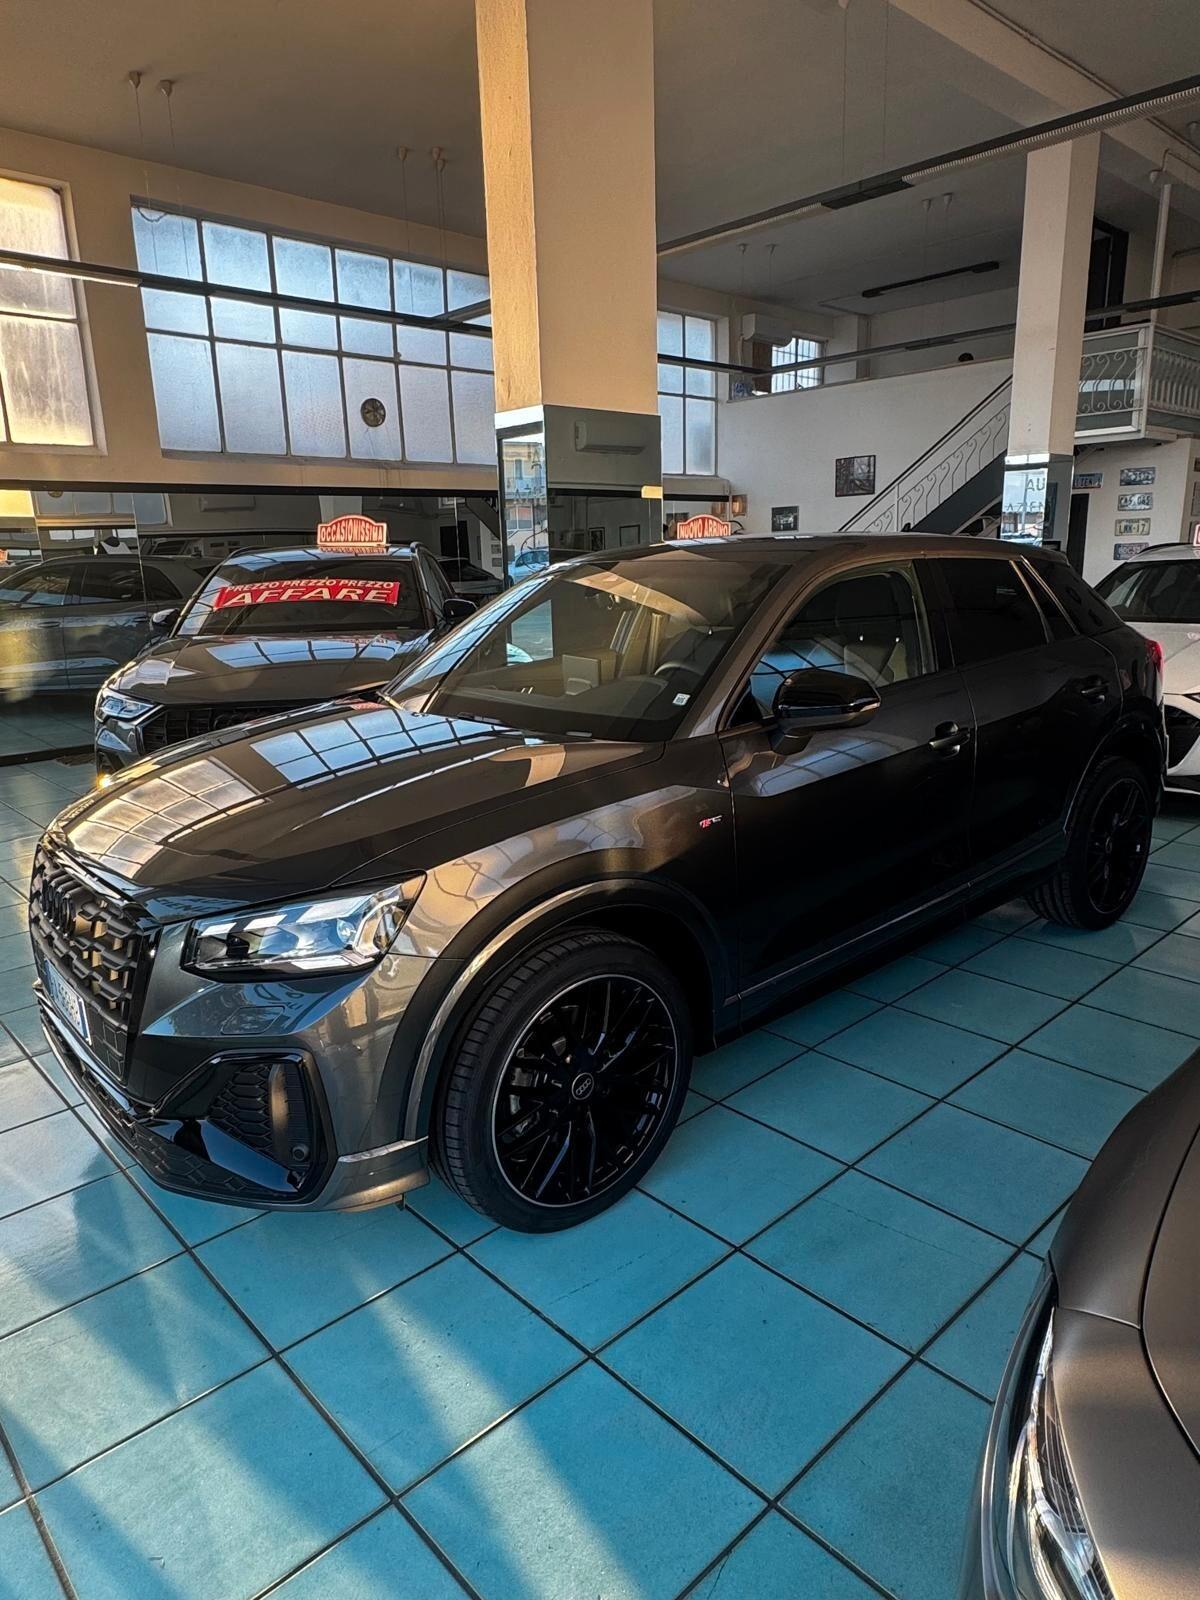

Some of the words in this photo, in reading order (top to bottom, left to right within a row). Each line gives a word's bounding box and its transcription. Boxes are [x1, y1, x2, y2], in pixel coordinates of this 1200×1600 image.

[320, 518, 383, 542] OCCASIONISSIMA
[679, 518, 703, 539] NUOVO
[703, 517, 728, 537] ARRIVO
[226, 581, 280, 593] PREZZO
[281, 578, 337, 588] PREZZO
[338, 579, 394, 590] PREZZO
[223, 586, 392, 607] AFFARE
